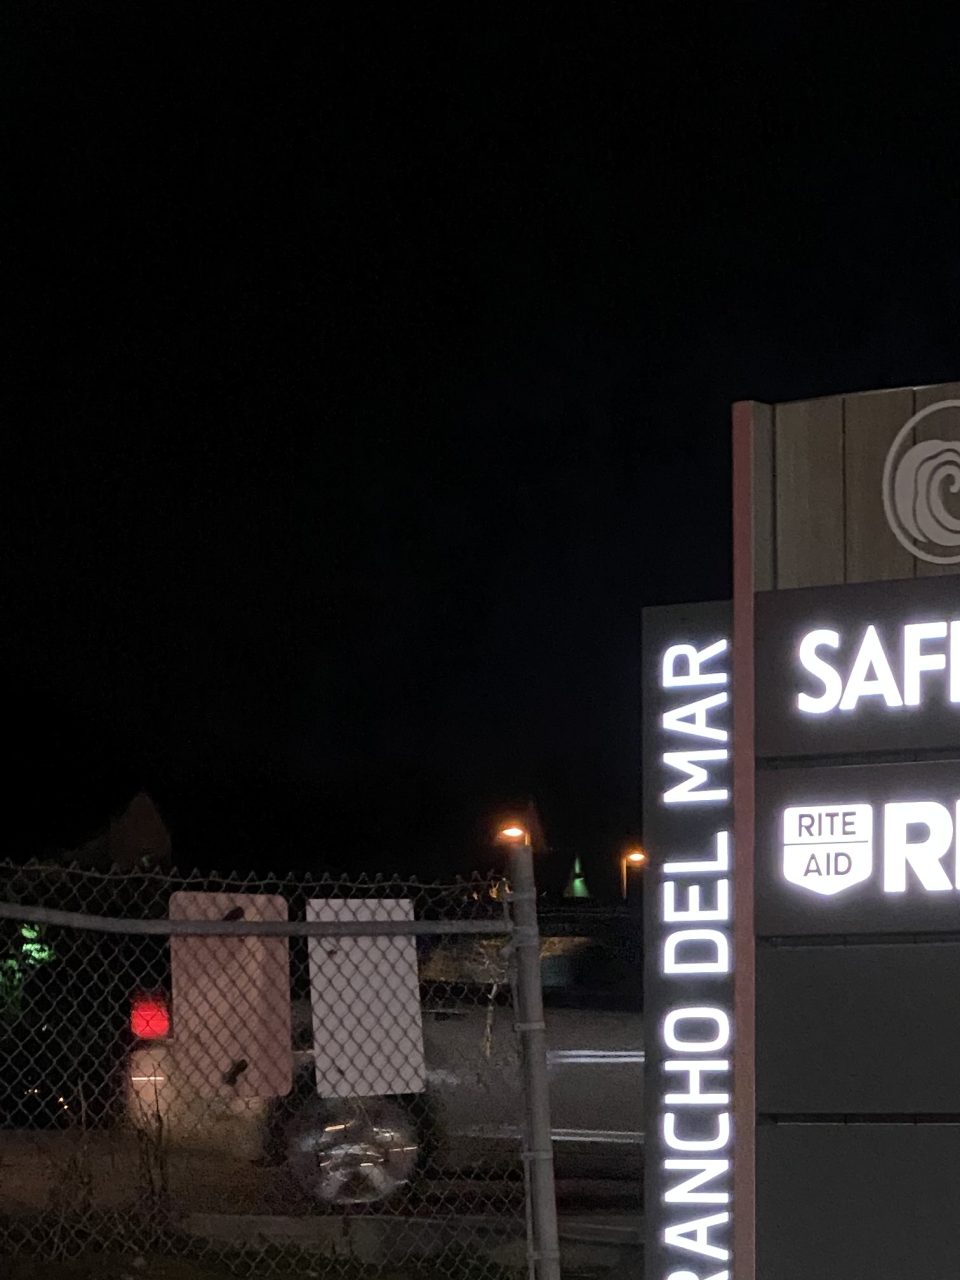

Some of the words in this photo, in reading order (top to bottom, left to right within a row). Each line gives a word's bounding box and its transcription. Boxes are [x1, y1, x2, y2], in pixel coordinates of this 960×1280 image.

[661, 638, 729, 804] MAR
[798, 811, 857, 837] RITE
[803, 852, 852, 877] AID
[662, 829, 730, 975] DEL
